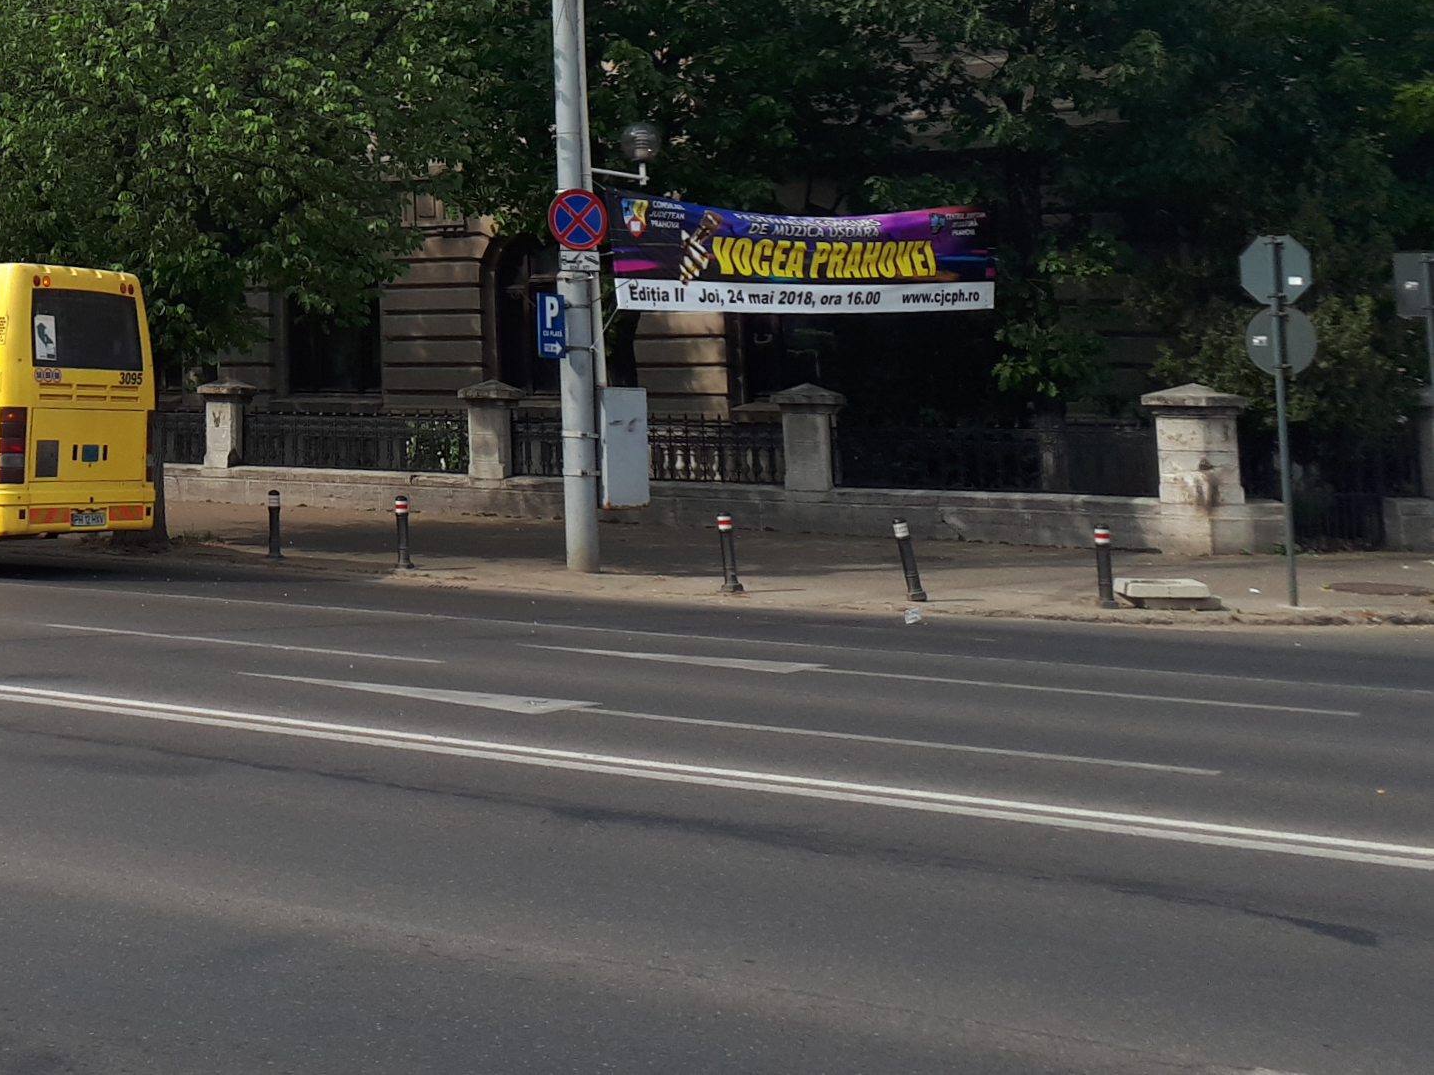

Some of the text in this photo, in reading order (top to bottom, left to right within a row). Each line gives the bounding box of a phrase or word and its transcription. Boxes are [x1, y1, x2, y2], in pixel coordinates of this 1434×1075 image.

[650, 219, 680, 229] PRAHOVA
[748, 222, 770, 235] DE
[712, 236, 937, 279] VOCEA PRAHOVEI
[628, 287, 670, 307] Ediția
[698, 288, 724, 306] Joi,
[727, 289, 745, 304] 24
[748, 290, 775, 305] mai
[777, 290, 816, 308] 2018,
[820, 293, 842, 306] ora
[846, 290, 881, 306] 16.00
[901, 289, 980, 307] www.cjcph.ro
[545, 295, 560, 329] P
[118, 372, 143, 385] 3095
